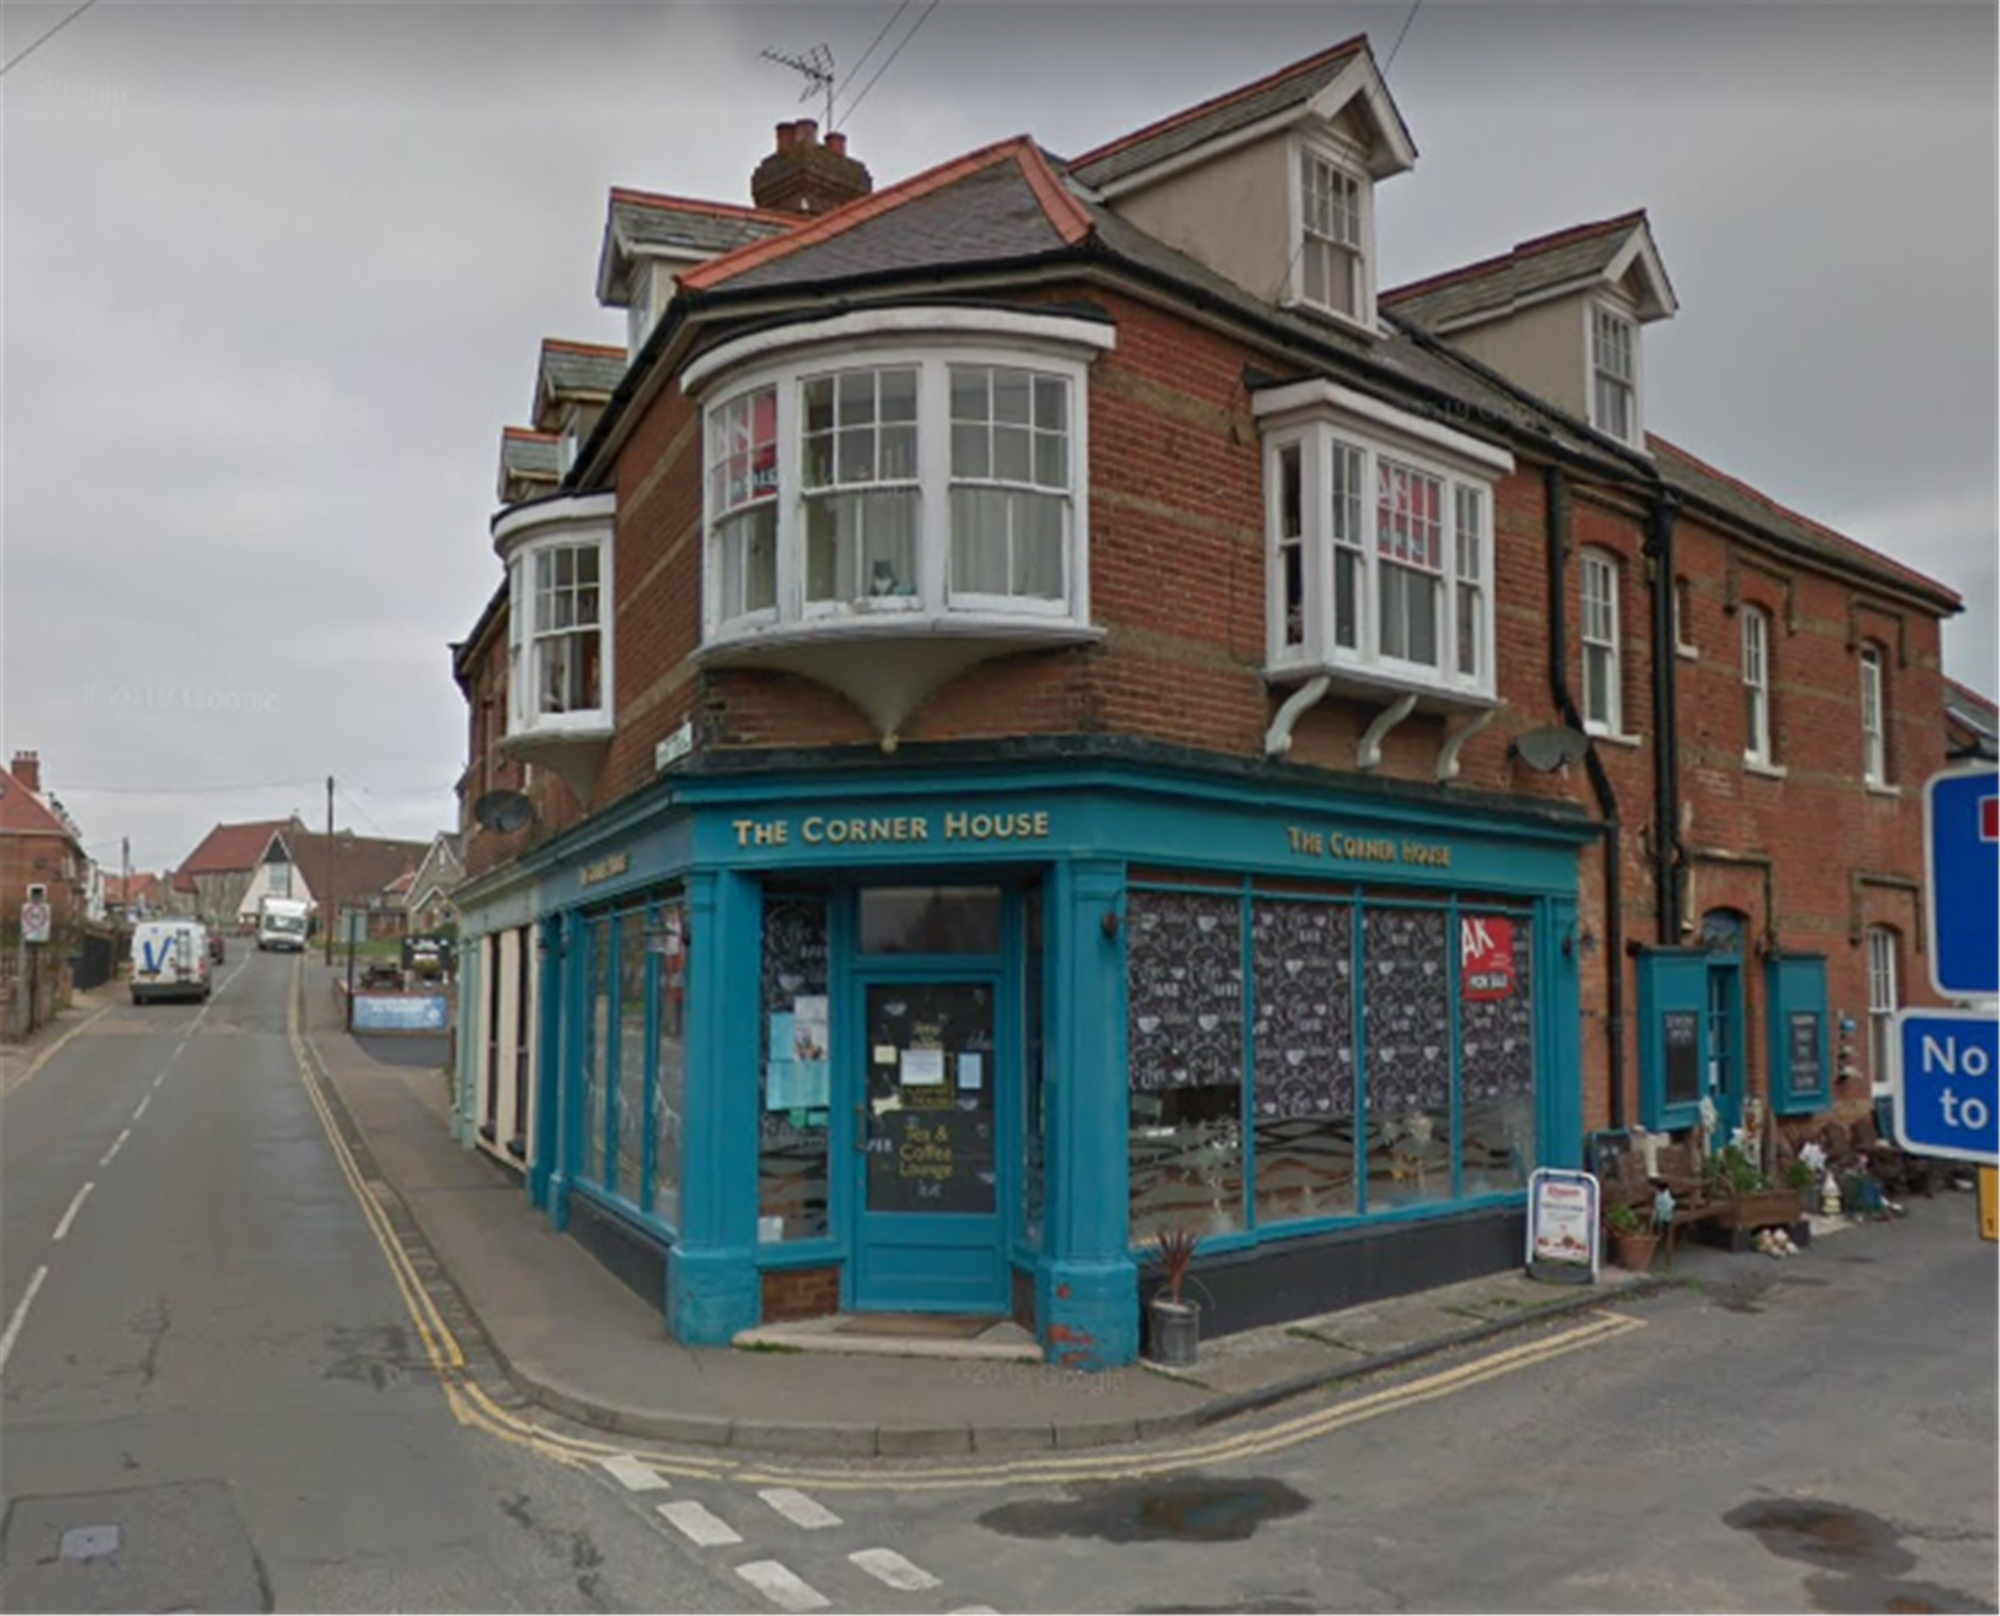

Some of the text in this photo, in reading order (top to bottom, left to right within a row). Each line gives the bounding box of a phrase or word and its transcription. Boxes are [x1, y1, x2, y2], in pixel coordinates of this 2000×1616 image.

[733, 811, 1050, 845] THE CORNER HOUSE
[1287, 826, 1452, 869] THE CORNER HOUSE
[1922, 1035, 1989, 1077] No
[1939, 1087, 1988, 1129] to
